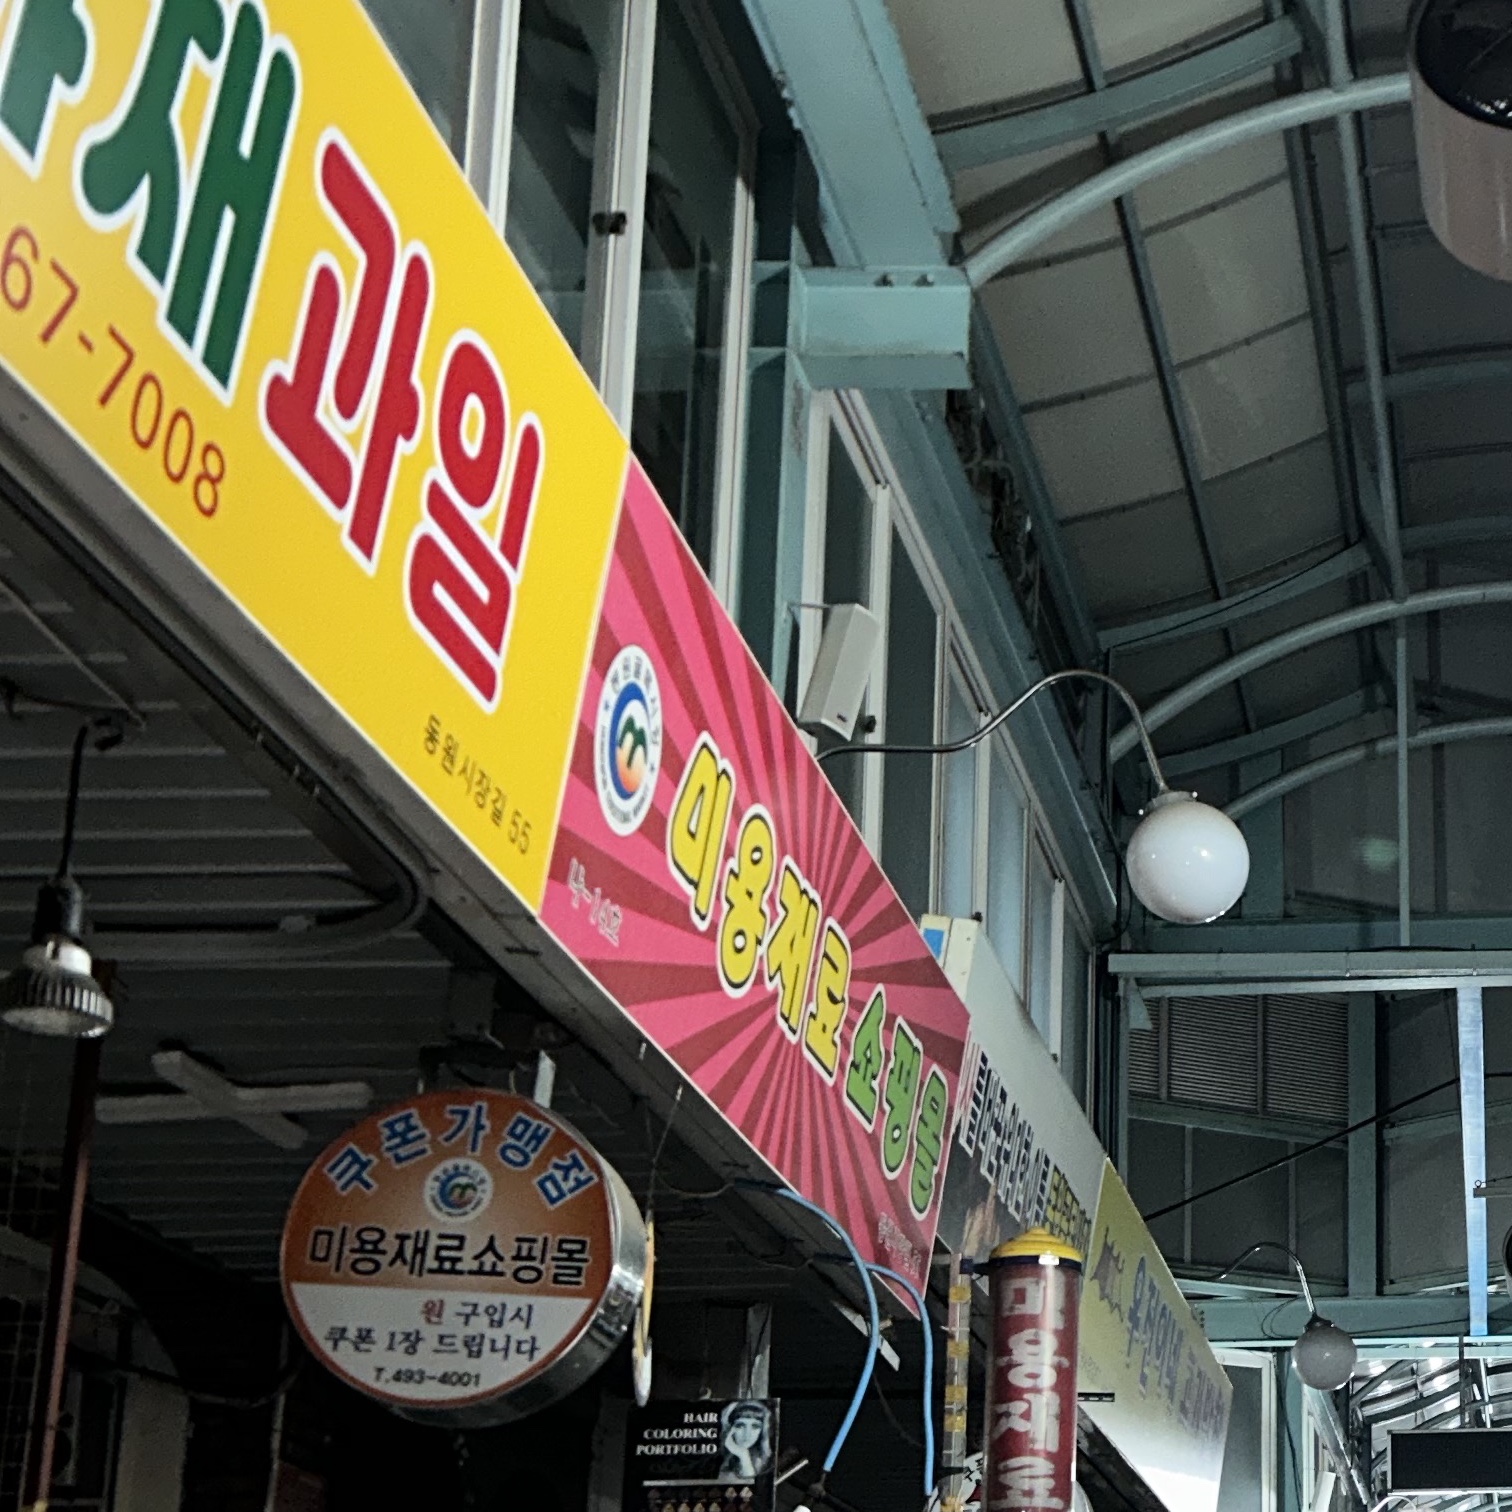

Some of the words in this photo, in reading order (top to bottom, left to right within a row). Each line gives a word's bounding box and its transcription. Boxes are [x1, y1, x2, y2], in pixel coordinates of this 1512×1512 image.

[309, 1227, 590, 1287] 미용재료쇼핑몰
[421, 1299, 446, 1325] 원
[454, 1301, 533, 1328] 구입시
[324, 1326, 377, 1353] 쿠폰
[386, 1329, 424, 1354] 1장
[432, 1332, 541, 1361] 드립니다
[683, 1413, 718, 1423] HAIR
[643, 1428, 718, 1440] COLORING
[636, 1443, 718, 1455] PORTFOLIO
